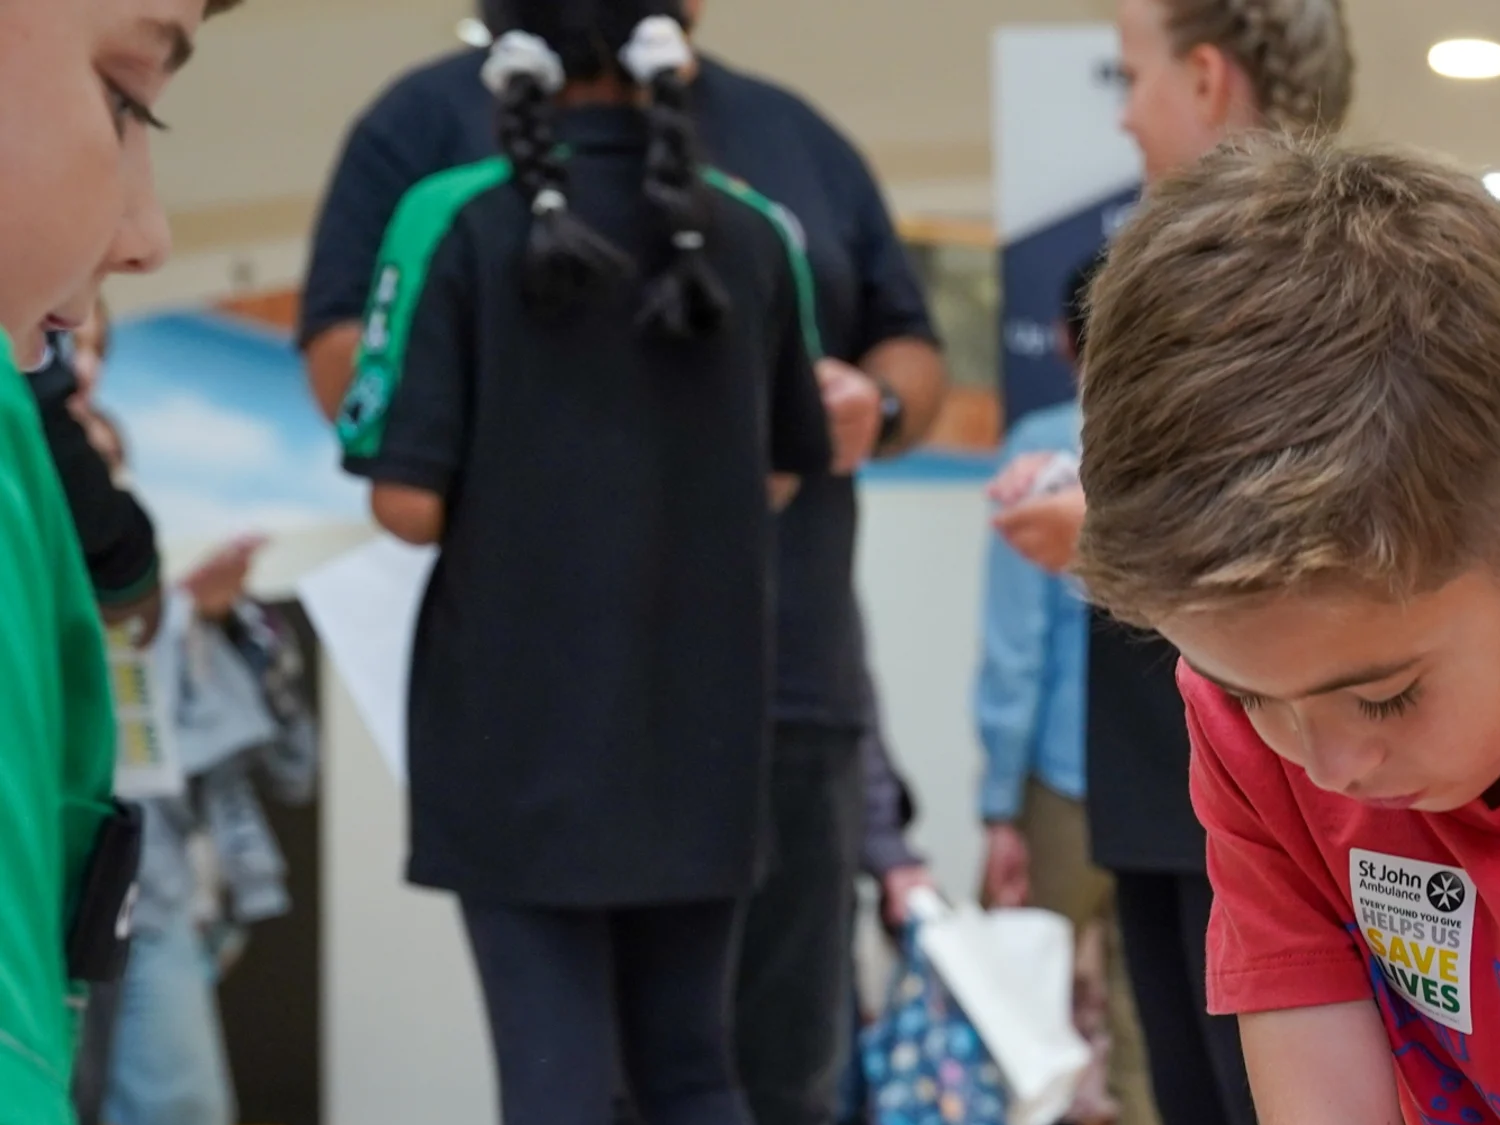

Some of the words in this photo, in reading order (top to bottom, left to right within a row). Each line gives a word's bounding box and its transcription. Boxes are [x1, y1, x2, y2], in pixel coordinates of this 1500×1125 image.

[1359, 860, 1376, 880] St
[1379, 864, 1422, 889] John
[1359, 879, 1421, 902] Ambulance
[1360, 898, 1385, 911] EVERY
[1387, 904, 1418, 919] POUND
[1420, 912, 1439, 924] YOU
[1440, 917, 1462, 928] GIVE
[1362, 907, 1425, 941] HELPS
[1431, 926, 1460, 949] US
[1366, 927, 1459, 983] SAVE
[1376, 954, 1461, 1014] LIVES
